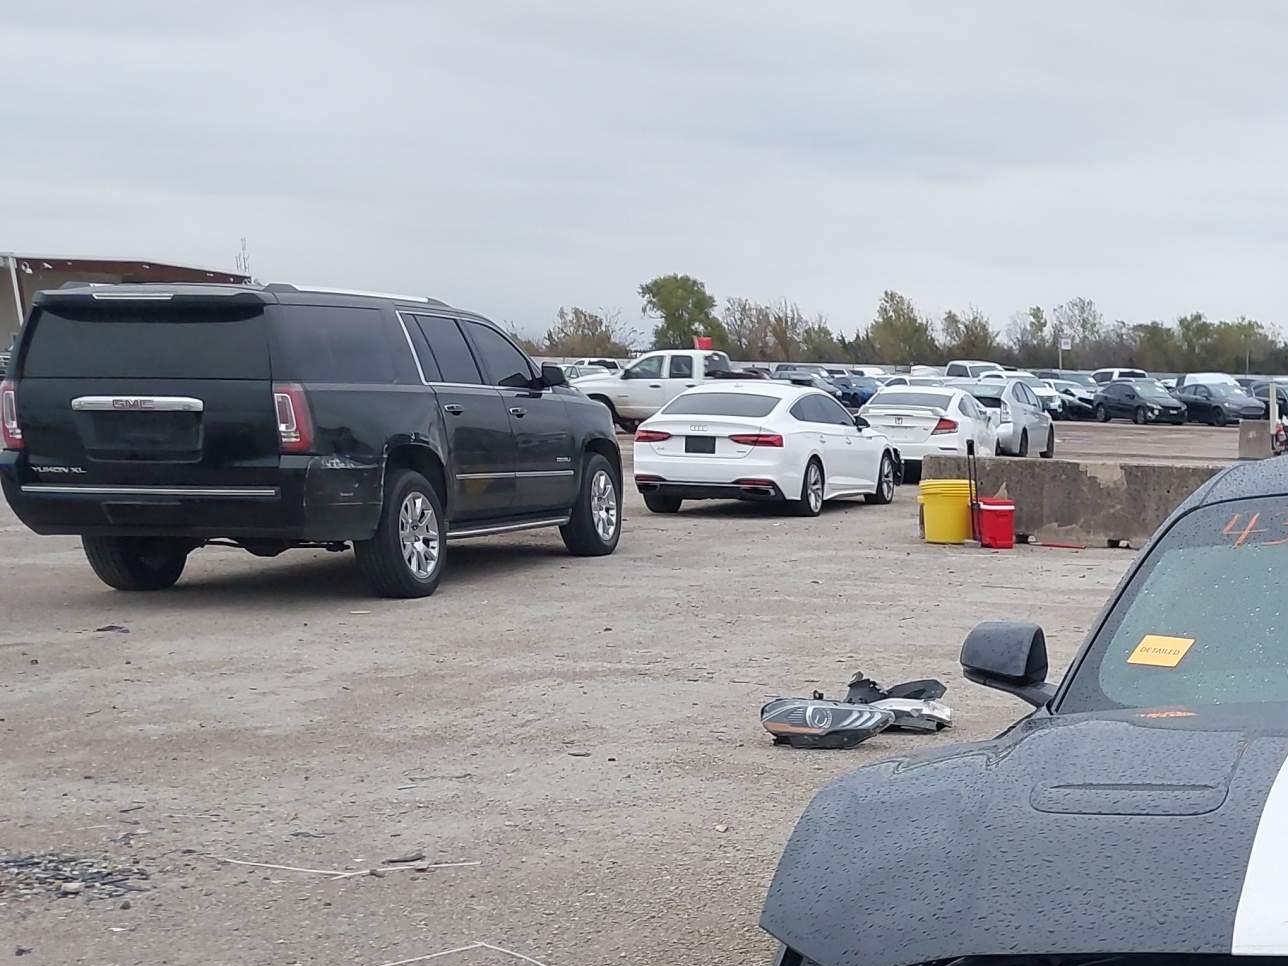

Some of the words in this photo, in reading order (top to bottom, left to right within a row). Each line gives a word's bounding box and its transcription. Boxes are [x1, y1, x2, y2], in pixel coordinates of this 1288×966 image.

[112, 399, 154, 409] GMC
[31, 465, 69, 473] YUKON
[1140, 646, 1181, 656] DETAILED
